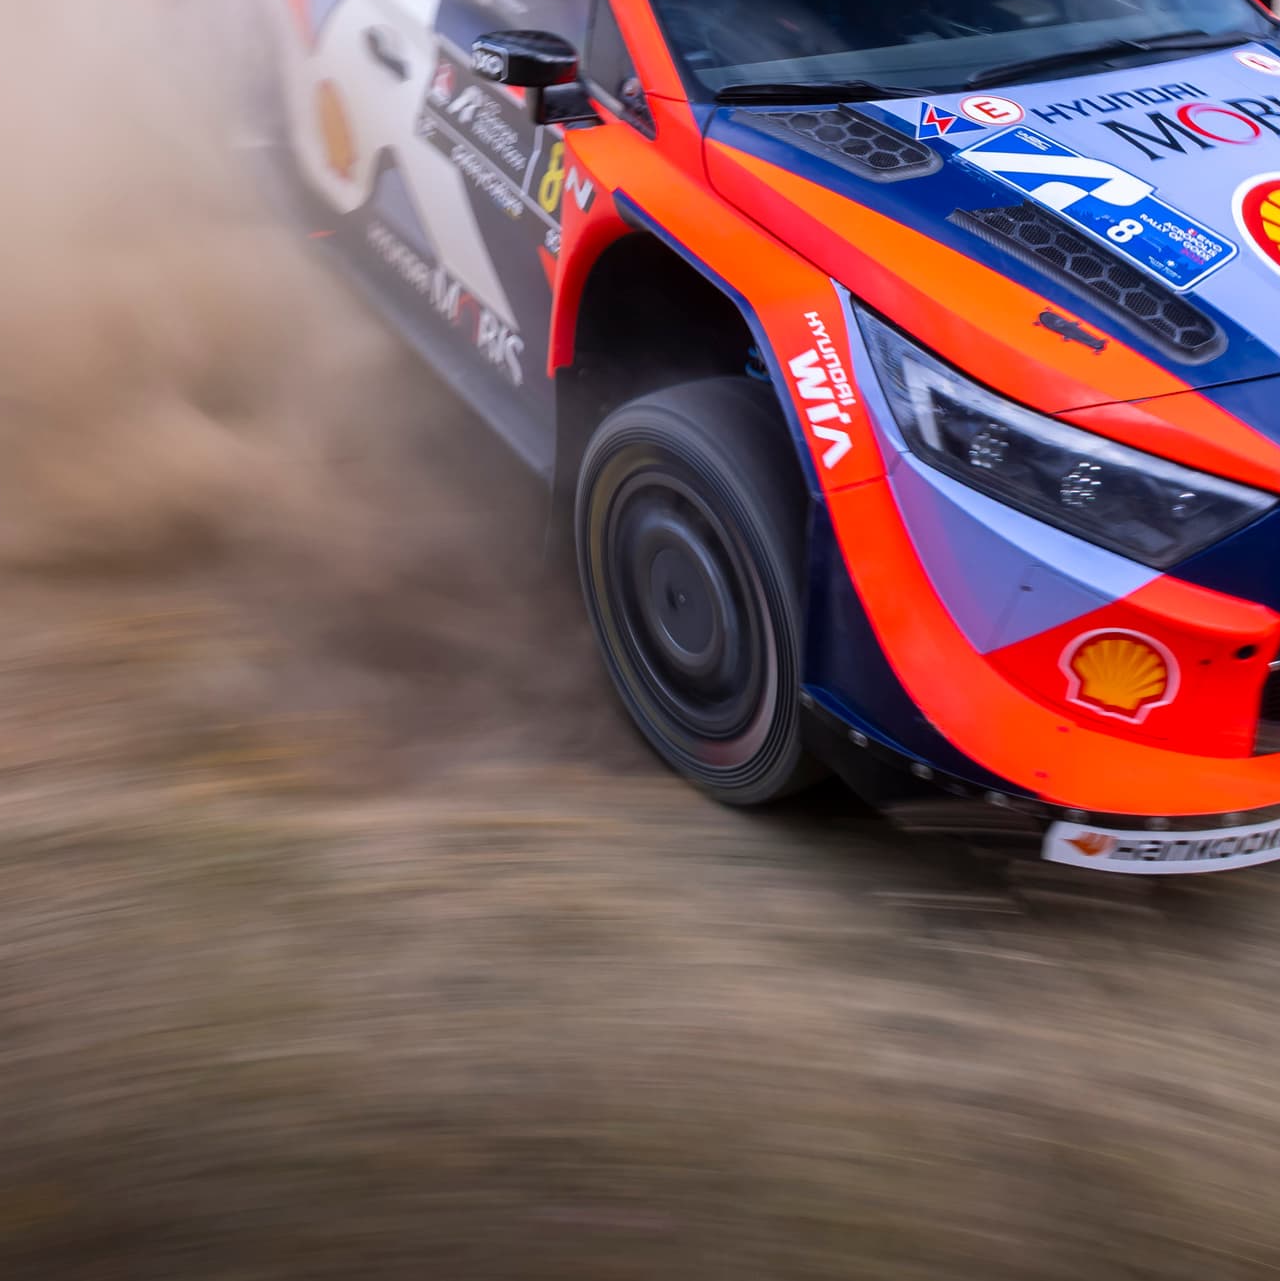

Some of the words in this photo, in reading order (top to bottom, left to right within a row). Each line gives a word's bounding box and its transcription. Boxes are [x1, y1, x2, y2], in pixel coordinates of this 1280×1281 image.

[974, 101, 1010, 120] E
[1030, 81, 1209, 124] HYUNDAI
[1106, 218, 1144, 243] 8
[804, 311, 856, 406] HYUNDAI
